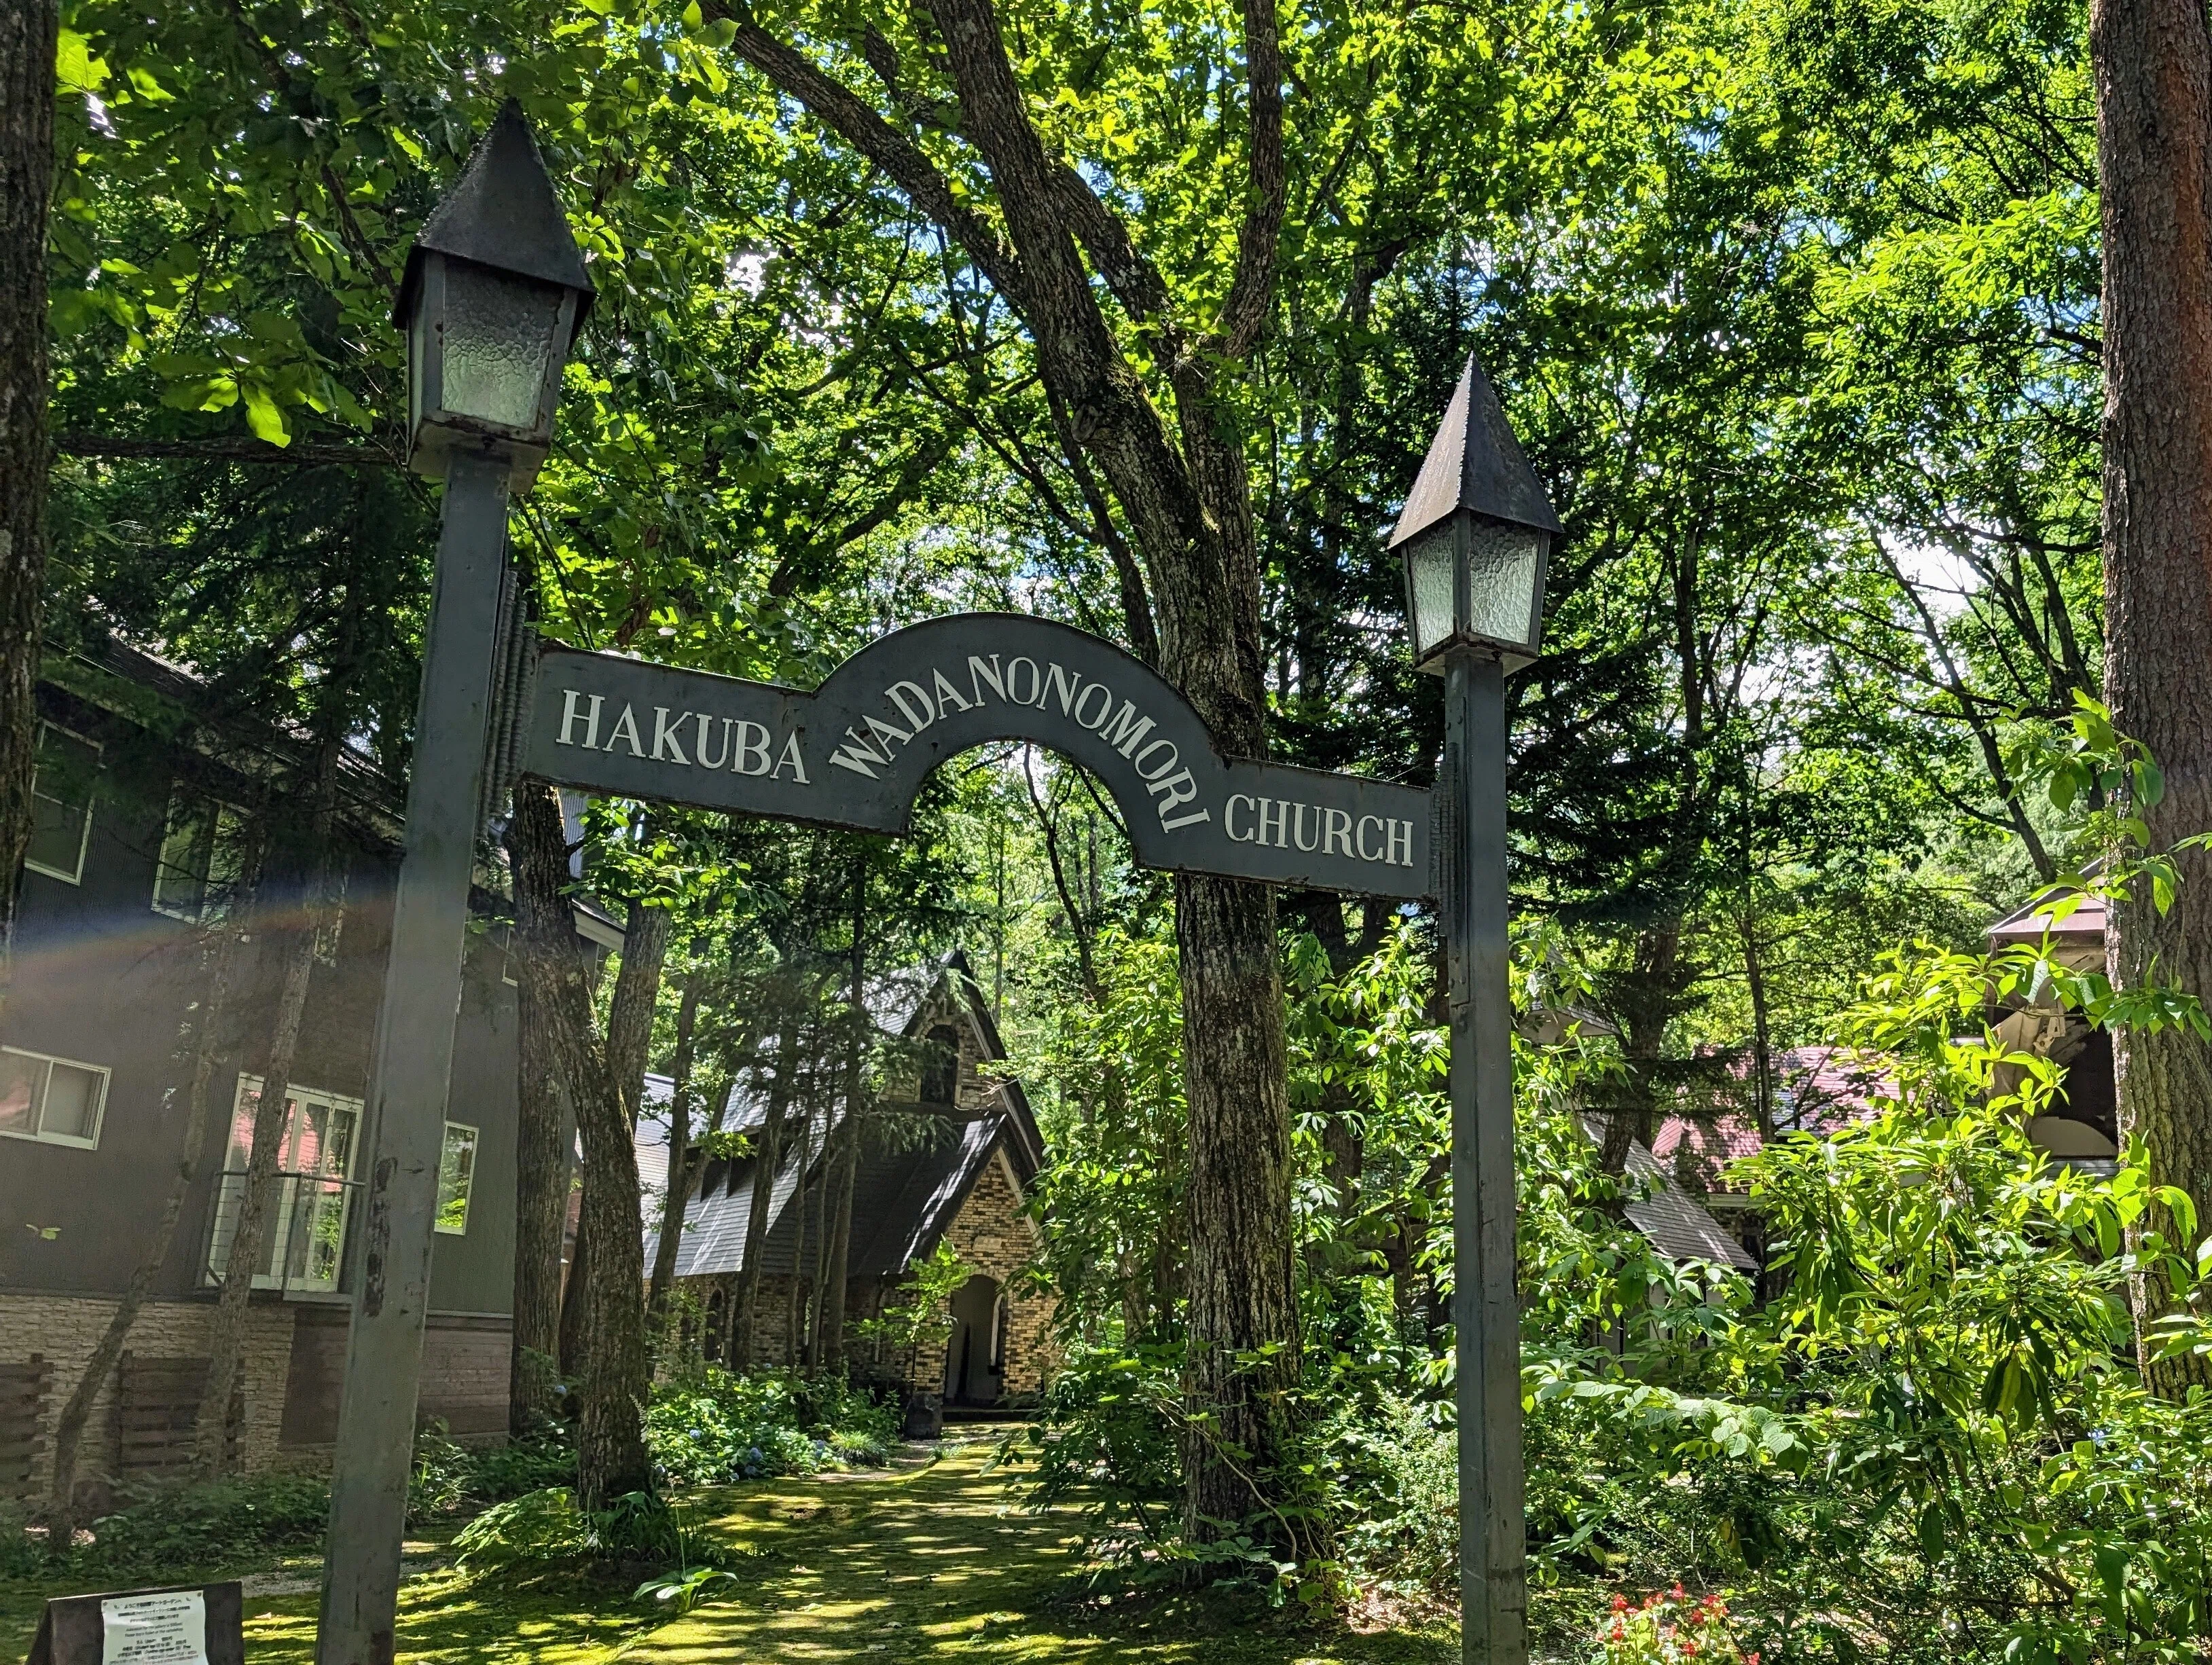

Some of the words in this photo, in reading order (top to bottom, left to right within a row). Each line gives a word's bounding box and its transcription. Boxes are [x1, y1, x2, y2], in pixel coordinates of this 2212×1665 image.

[556, 689, 810, 784] HAKUBA
[828, 654, 1210, 835] WADANONOMORI
[1225, 794, 1414, 867] CHURCH
